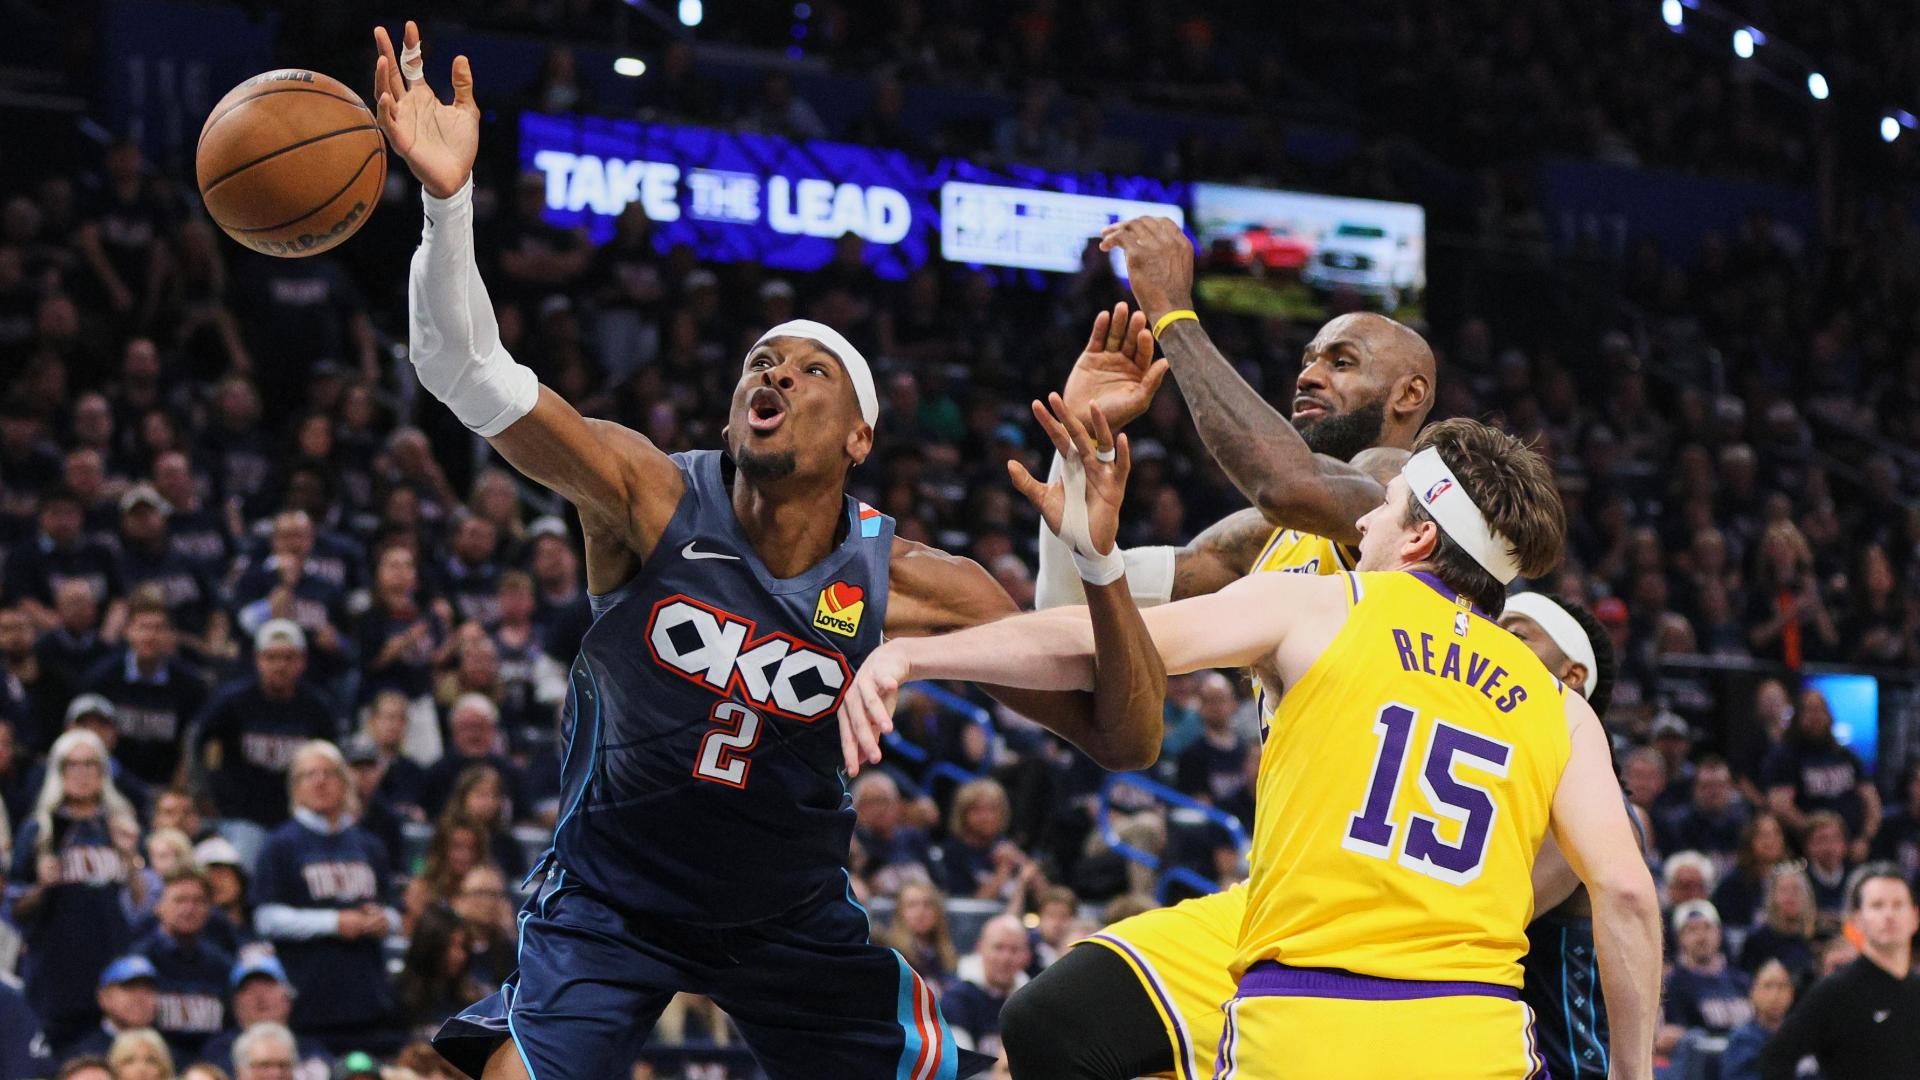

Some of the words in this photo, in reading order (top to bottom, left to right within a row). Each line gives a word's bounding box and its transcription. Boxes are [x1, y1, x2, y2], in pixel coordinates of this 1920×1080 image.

[534, 151, 680, 222] TAKE
[687, 171, 760, 222] THE
[768, 175, 912, 244] LEAD
[648, 598, 852, 720] OKC
[1392, 628, 1527, 714] REAVES
[693, 698, 763, 789] 2
[1342, 701, 1512, 885] 15
